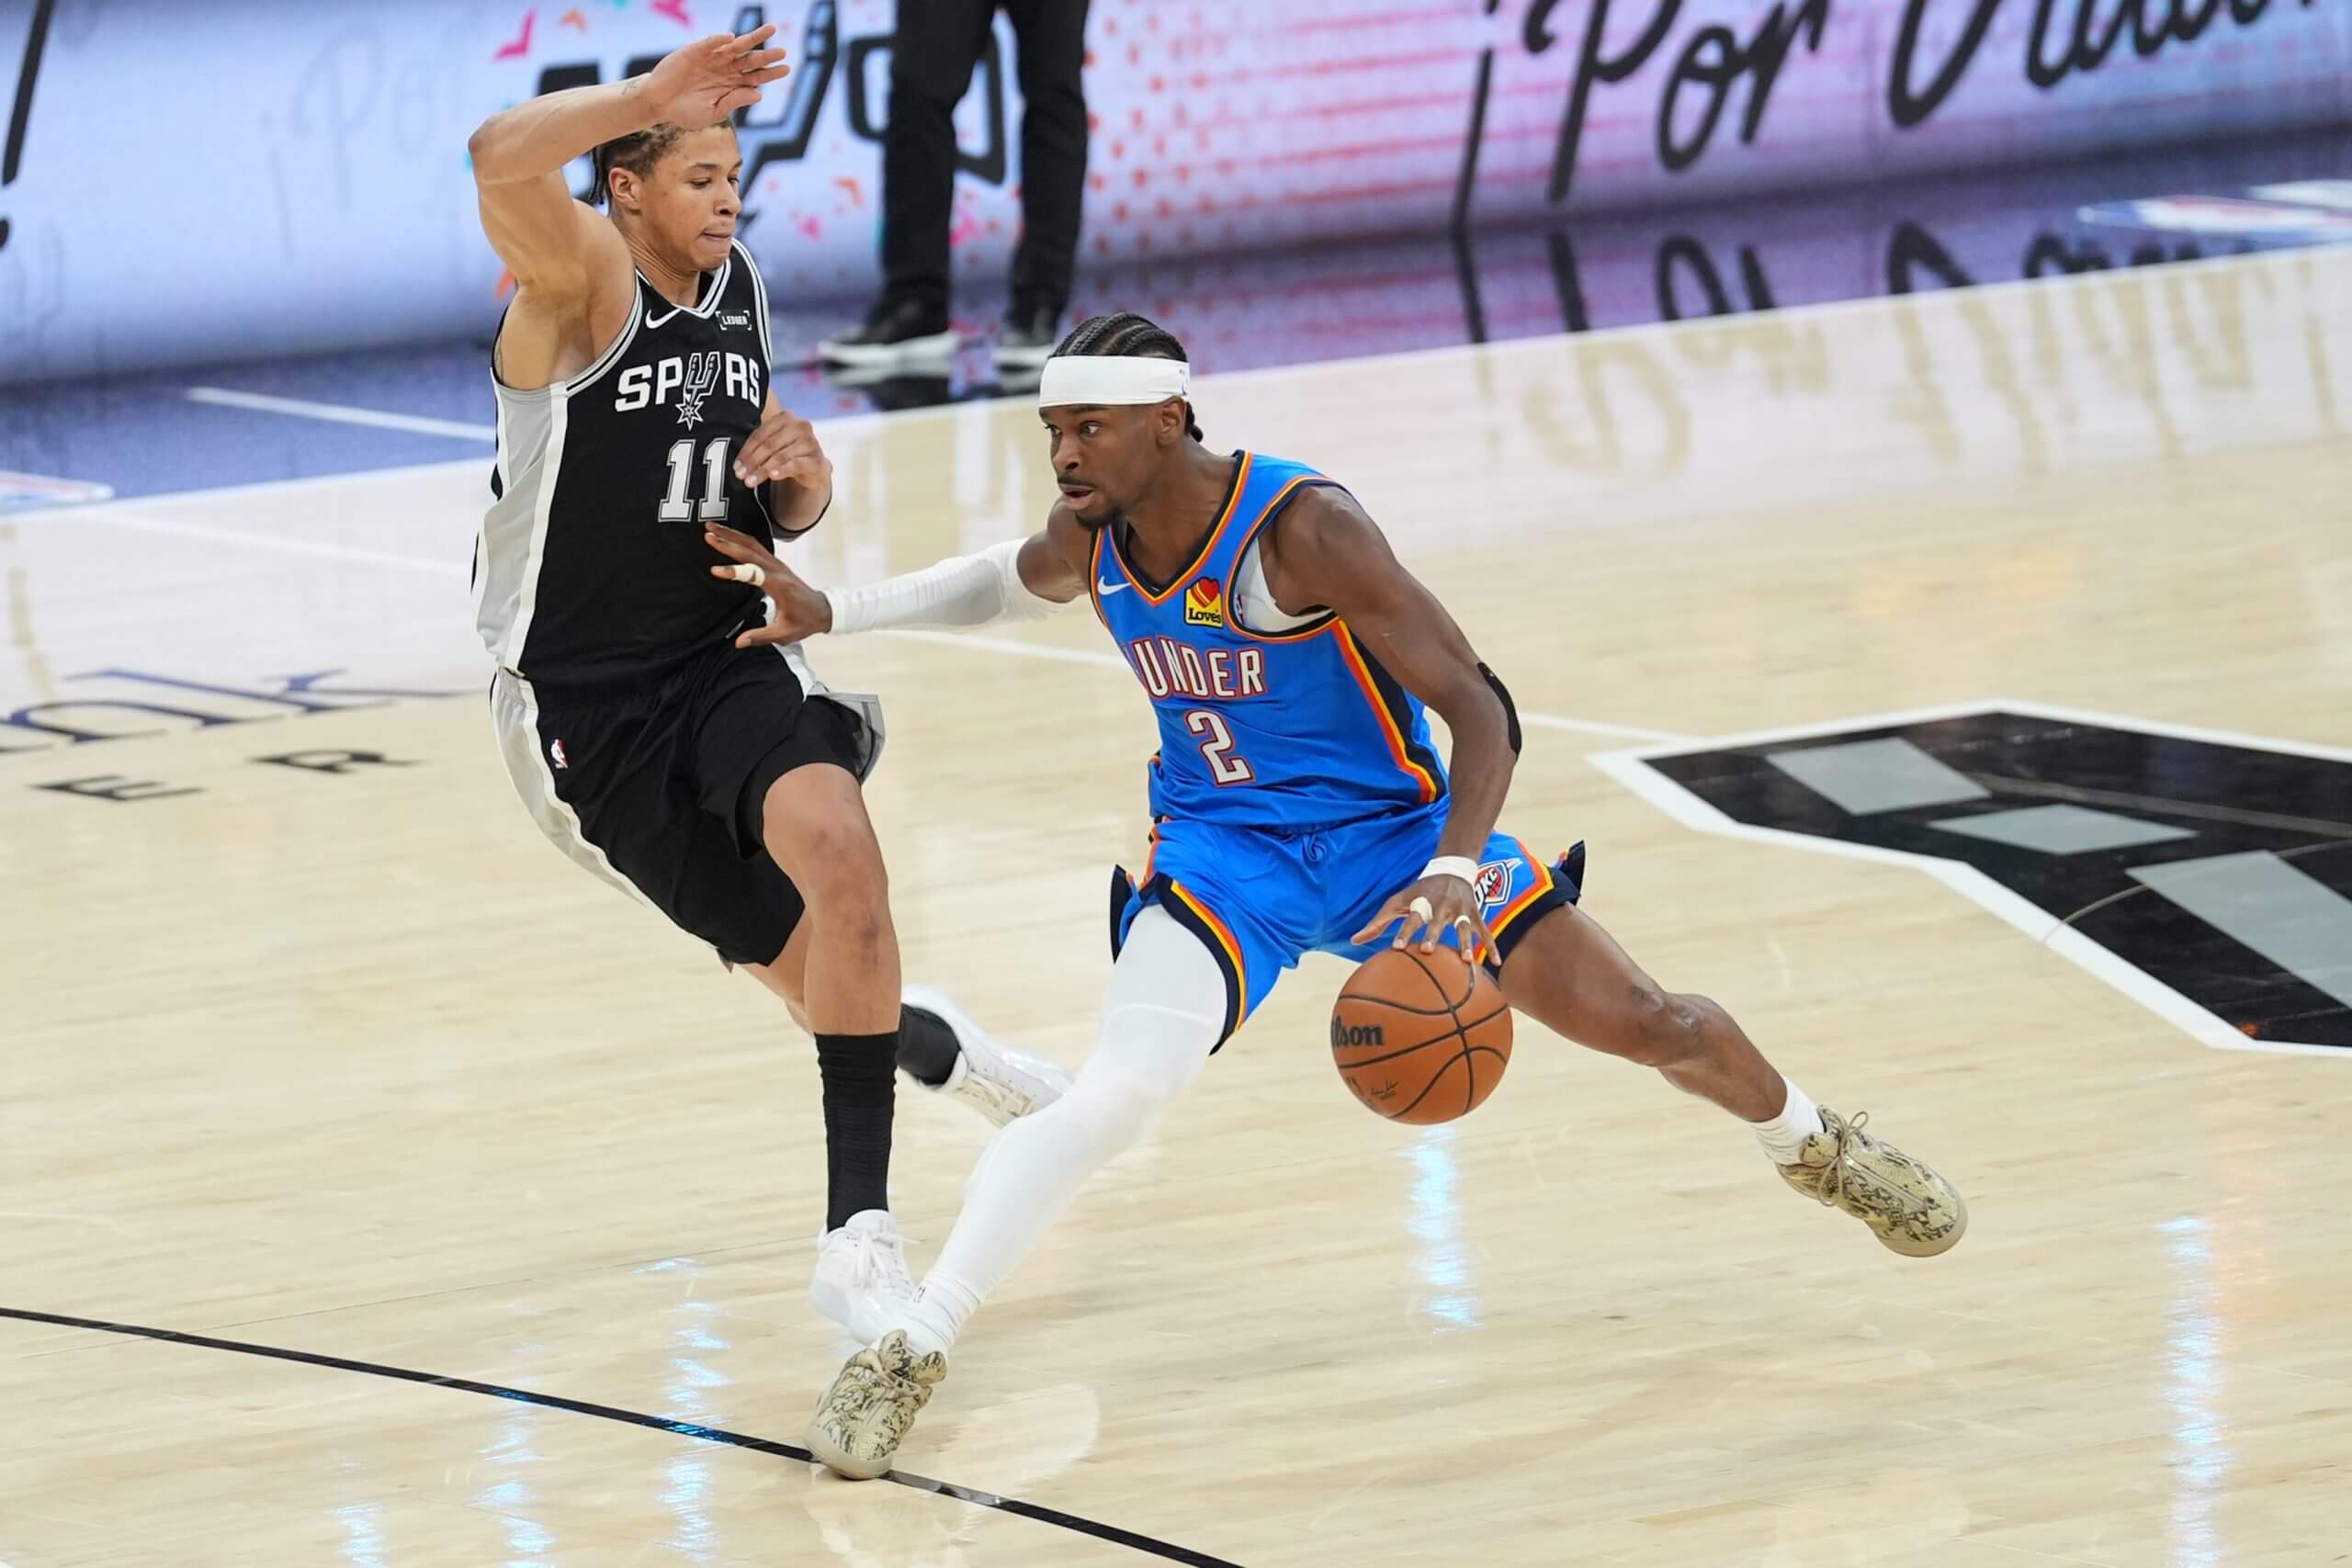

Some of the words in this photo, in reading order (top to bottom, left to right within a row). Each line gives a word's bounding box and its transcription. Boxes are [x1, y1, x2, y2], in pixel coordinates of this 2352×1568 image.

[615, 352, 760, 430] SPURS
[658, 437, 731, 522] 11
[1121, 636, 1267, 700] UNDER
[1184, 708, 1255, 787] 2
[1330, 1014, 1384, 1047] lson
